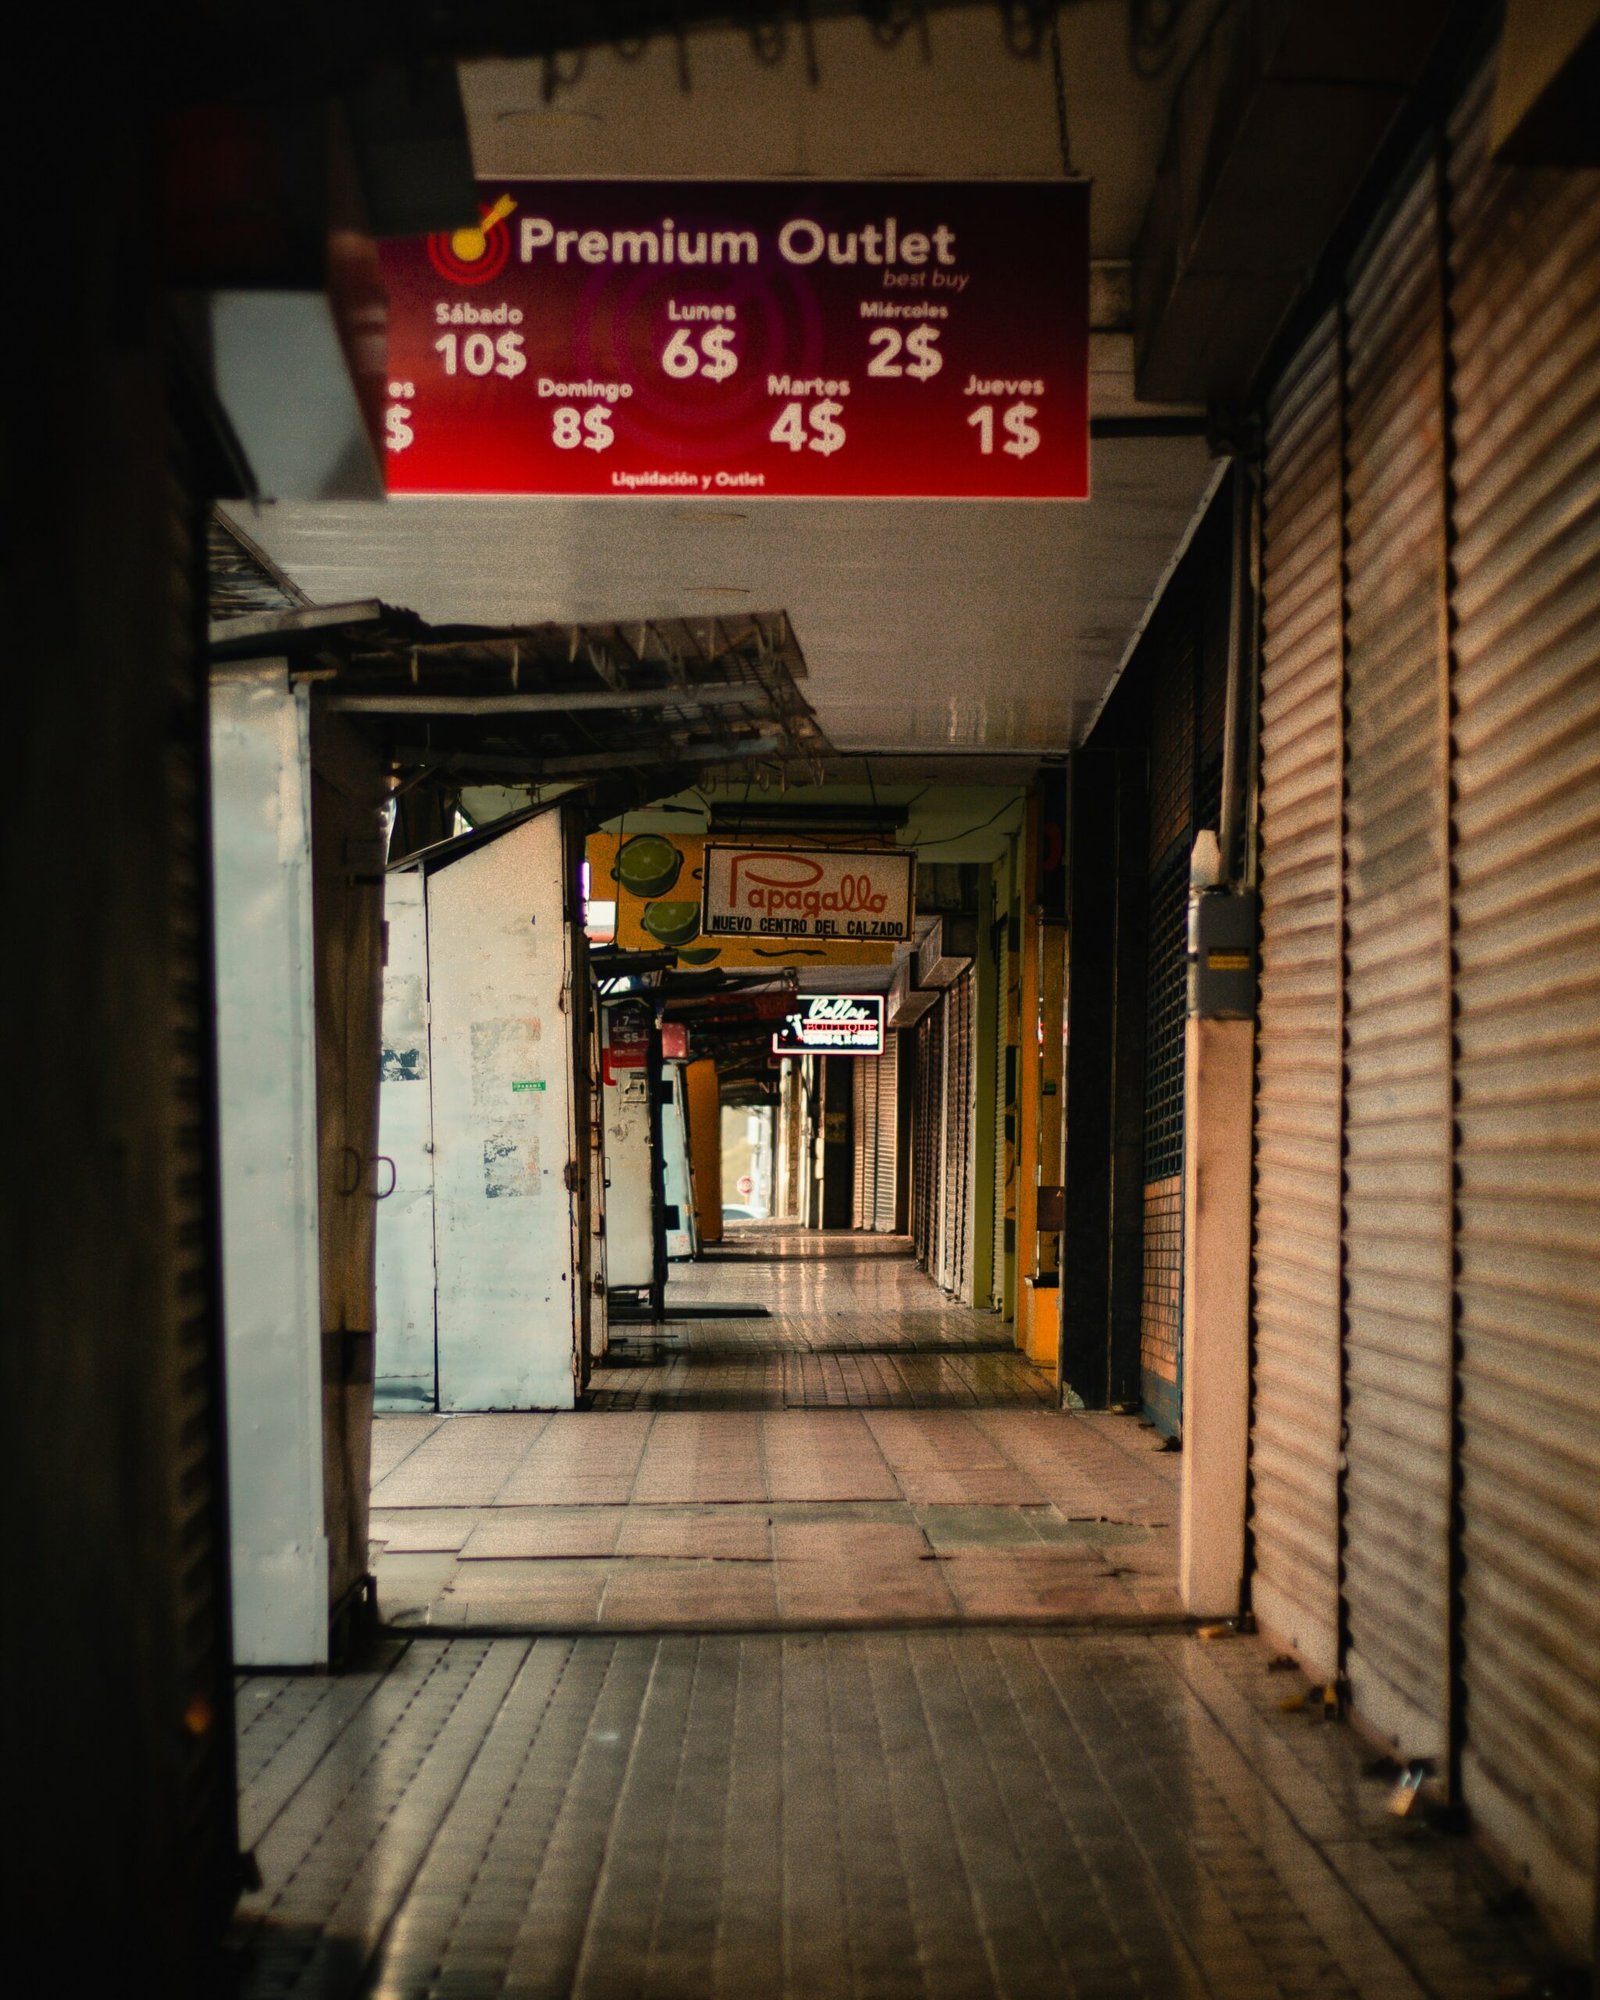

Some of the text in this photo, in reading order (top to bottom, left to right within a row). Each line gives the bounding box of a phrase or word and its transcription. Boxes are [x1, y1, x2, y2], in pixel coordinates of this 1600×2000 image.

[519, 217, 957, 265] Premium Outlet
[883, 268, 971, 293] best buy
[434, 300, 525, 326] Sábado
[667, 298, 738, 322] Lunes
[859, 301, 949, 318] Miércoles
[432, 331, 528, 381] 10$
[660, 322, 739, 384] 6$
[866, 322, 944, 383] 2$
[536, 376, 635, 403] Domingo
[766, 374, 852, 397] Martes
[963, 373, 1046, 396] Jueves
[550, 403, 616, 454] 8$
[768, 397, 848, 458] 4$
[966, 400, 1042, 460] 1$
[611, 470, 766, 491] Liquidación y Outlet
[729, 852, 888, 918] Papagallo
[713, 916, 903, 937] NUEVO CENTRO DEL CALZADO
